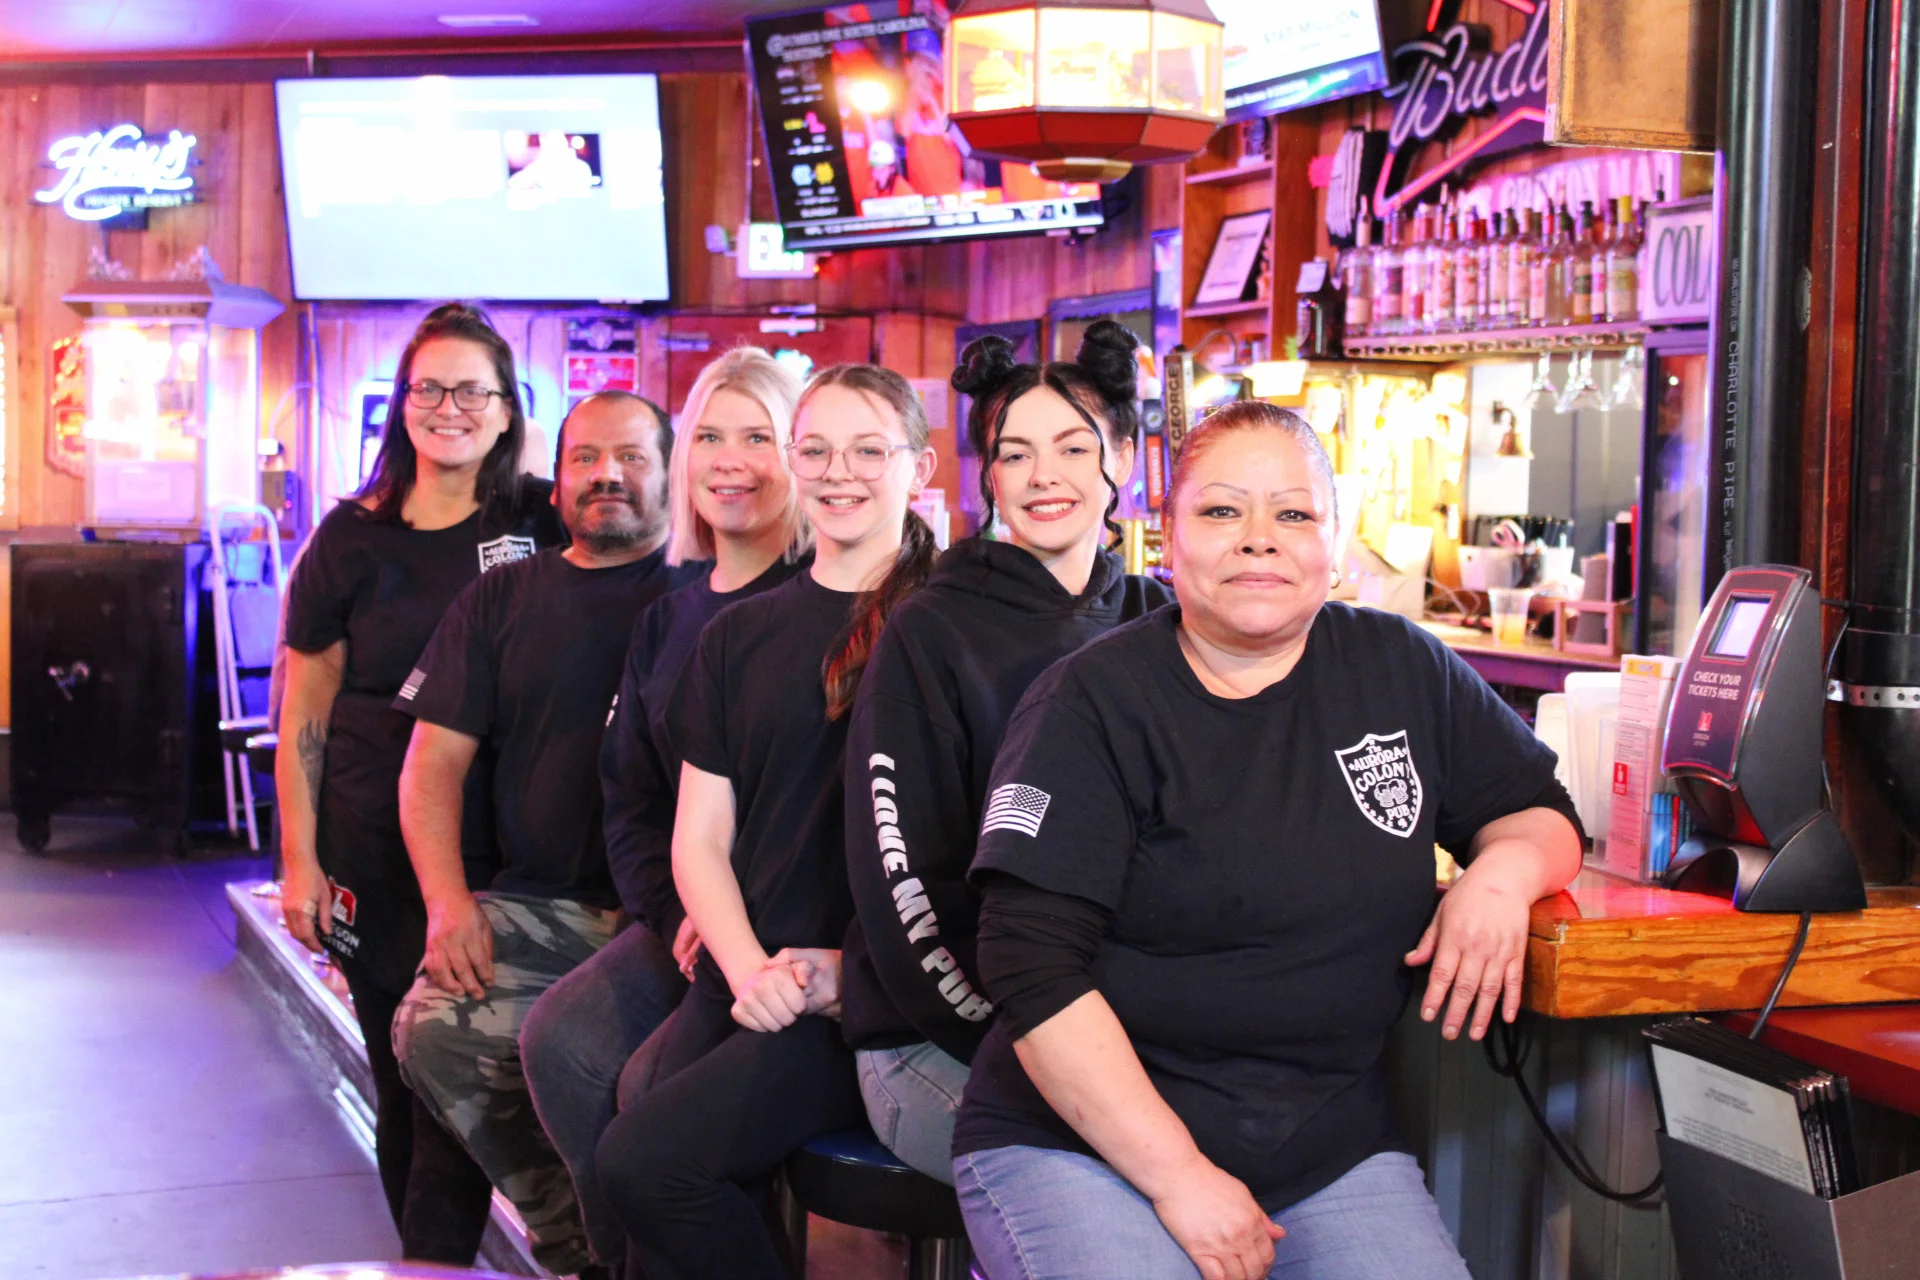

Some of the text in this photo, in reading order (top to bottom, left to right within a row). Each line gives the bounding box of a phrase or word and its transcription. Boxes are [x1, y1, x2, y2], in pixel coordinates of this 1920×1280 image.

[1654, 225, 1710, 306] COL
[1725, 341, 1739, 449] CHARLOTTE
[1694, 671, 1741, 686] CHECK YOUR
[1688, 684, 1739, 700] TICKETS HERE
[1353, 746, 1405, 771] AURORA
[1366, 745, 1382, 754] The
[1355, 762, 1412, 792] COLONY
[1385, 804, 1410, 820] PUB
[869, 753, 993, 1022] I LOVE MY PUB
